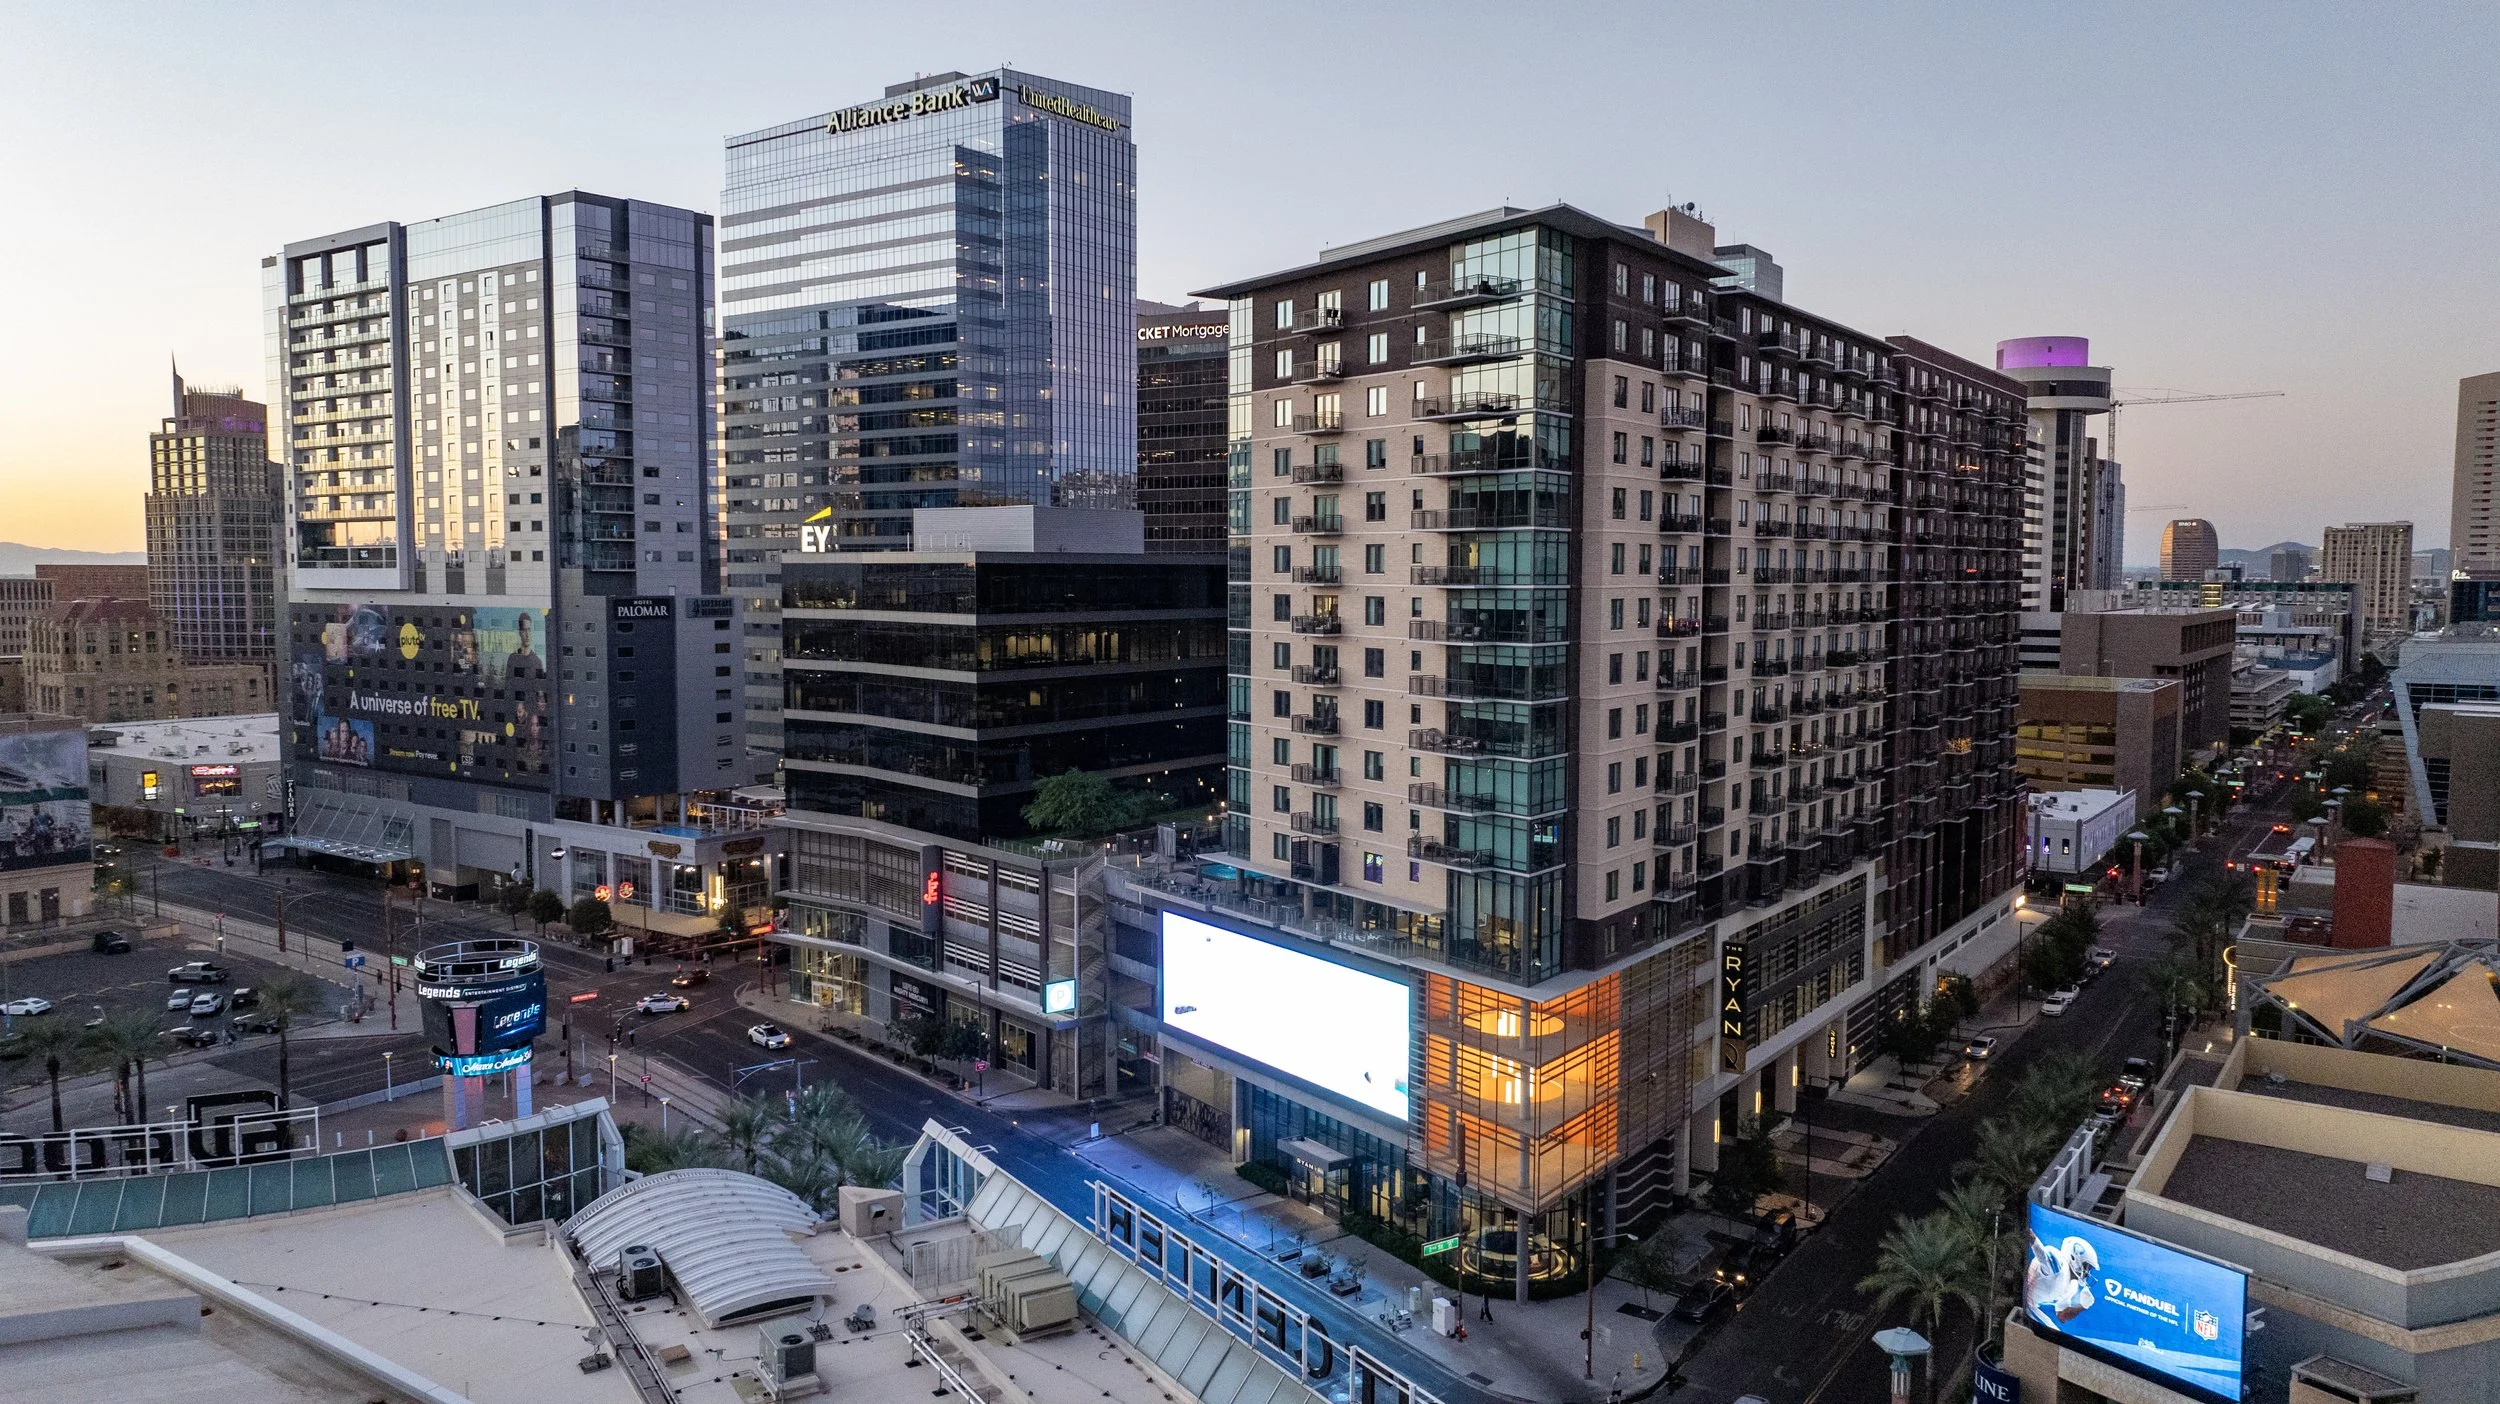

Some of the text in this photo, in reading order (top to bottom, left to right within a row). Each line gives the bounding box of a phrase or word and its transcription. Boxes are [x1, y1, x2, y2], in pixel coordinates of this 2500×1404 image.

[826, 84, 967, 134] Alliance Bank
[1020, 84, 1120, 131] UnitedHealthcare
[1172, 325, 1230, 339] Mortgage
[802, 525, 831, 552] EY
[618, 606, 668, 616] PALOMAR
[400, 636, 420, 647] pluto
[350, 690, 481, 720] A universe of free TV.
[415, 750, 425, 760] Pay
[286, 782, 296, 818] PALOMAR
[352, 957, 360, 967] P
[499, 952, 537, 969] Legends
[418, 983, 461, 999] Legends
[464, 984, 525, 996] ENTERTAINMENT DISTRICT
[1056, 990, 1065, 1005] P
[1724, 956, 1742, 1036] RYAN
[493, 1003, 541, 1029] Legends
[2123, 1287, 2180, 1317] FANDUEL
[2104, 1296, 2126, 1307] OFFICIAL
[2126, 1304, 2150, 1316] PARTNER
[2157, 1314, 2169, 1323] THE
[2168, 1318, 2179, 1327] NFL
[2196, 1321, 2215, 1337] NFL
